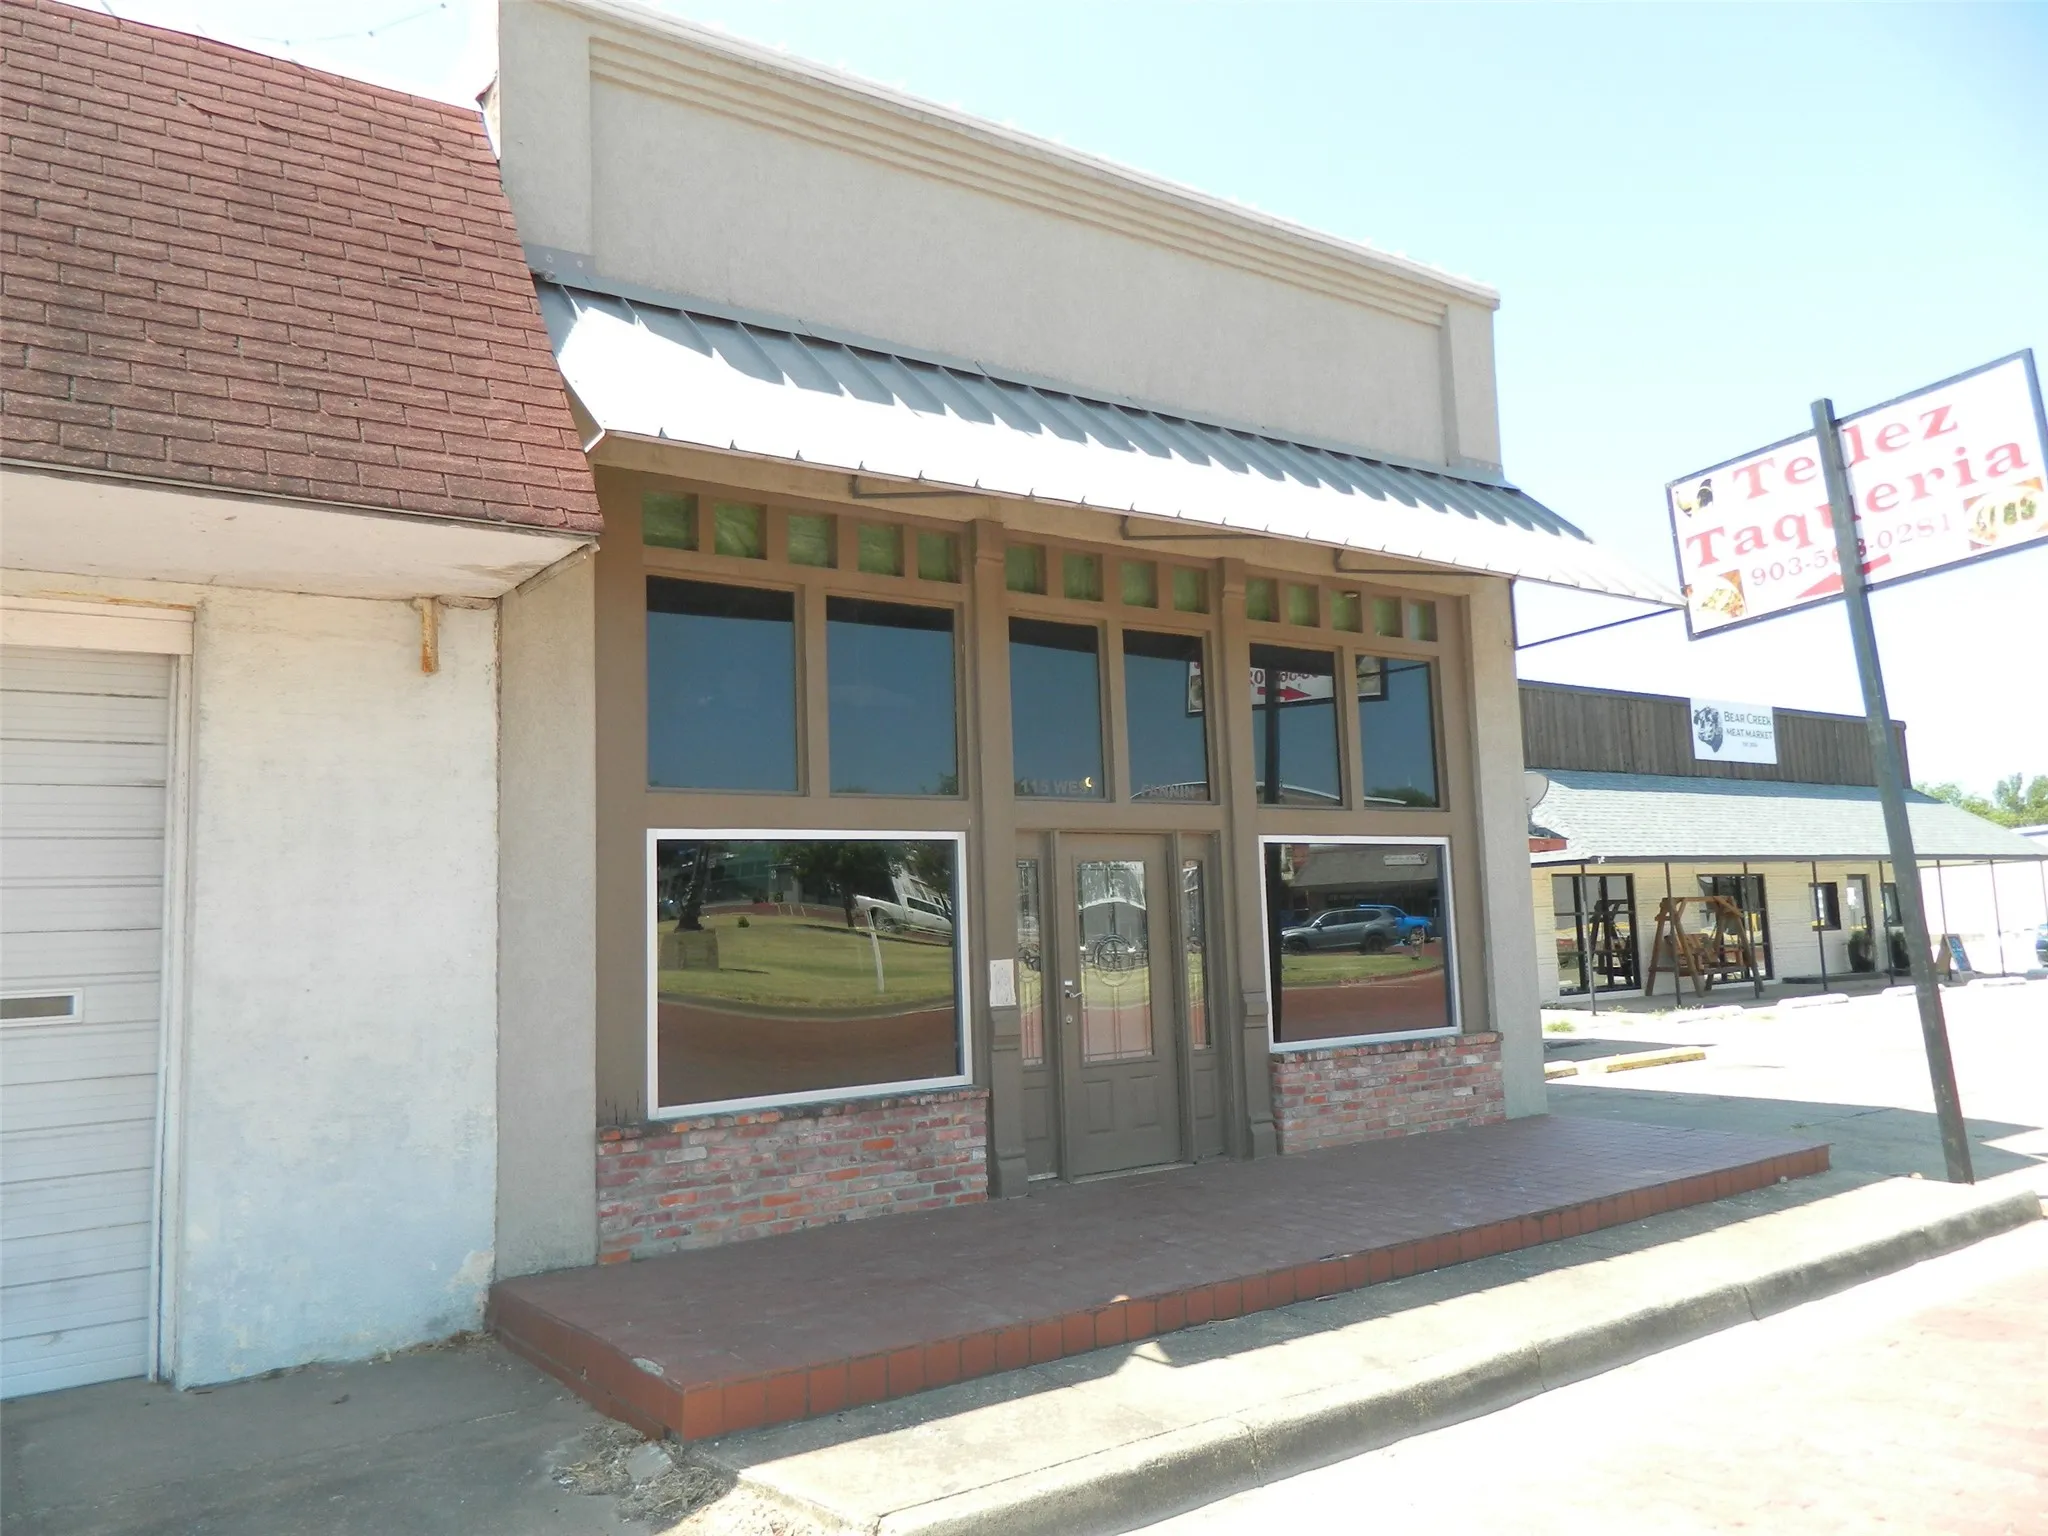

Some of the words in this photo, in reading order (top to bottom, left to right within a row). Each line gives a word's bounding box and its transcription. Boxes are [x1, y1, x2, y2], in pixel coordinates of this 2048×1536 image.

[1724, 711, 1745, 723] BEAR
[1746, 713, 1772, 726] CREEK
[1726, 728, 1744, 737] MEAT
[1745, 729, 1773, 740] MARKET
